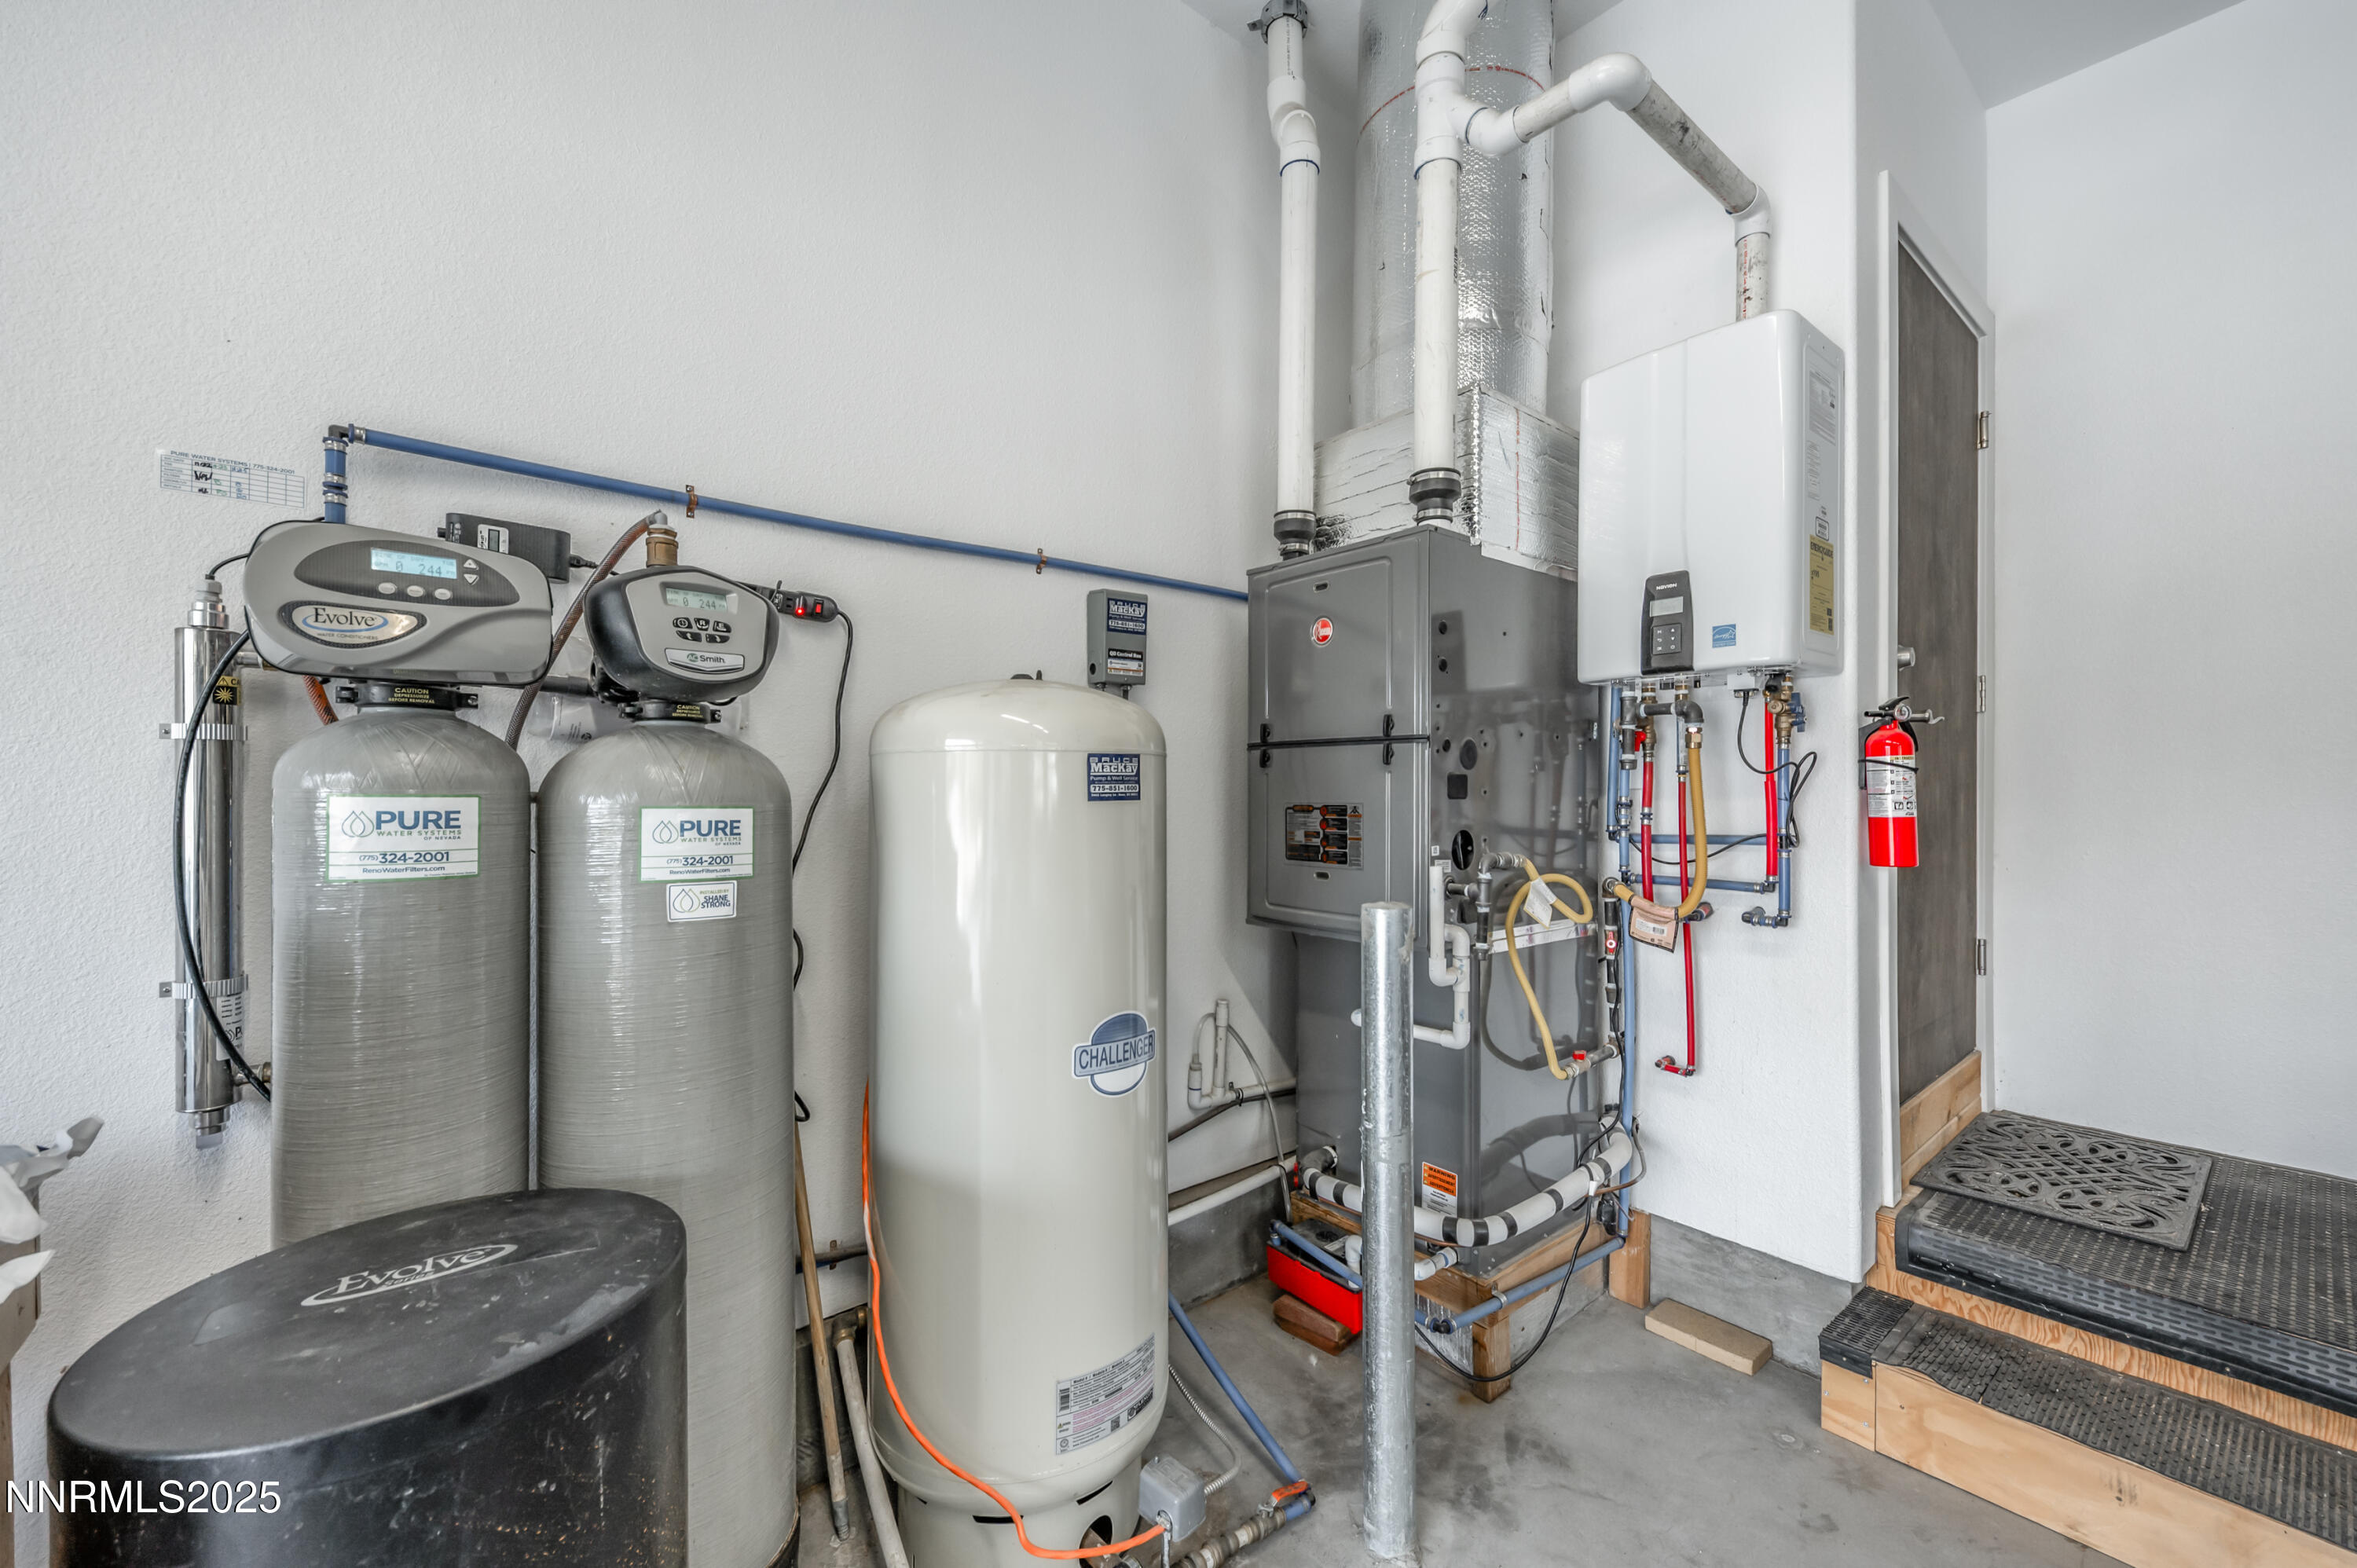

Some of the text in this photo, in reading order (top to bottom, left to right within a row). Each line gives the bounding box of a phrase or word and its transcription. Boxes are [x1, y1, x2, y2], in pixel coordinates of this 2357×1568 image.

[192, 453, 216, 462] WATER
[218, 458, 247, 467] SYSTEMS
[253, 463, 295, 474] 775-324-2001
[699, 599, 717, 610] 244
[313, 607, 376, 627] Evolve
[1109, 605, 1146, 617] MacKay
[699, 654, 724, 664] Smith
[1091, 763, 1138, 775] MacKay
[376, 810, 461, 830] PURE
[680, 819, 742, 837] PURE
[379, 851, 450, 864] 324-2001
[682, 855, 734, 866] 324-2001
[362, 866, 445, 874] RenoWaterFilters.com
[701, 899, 731, 909] STRONG
[1079, 1034, 1153, 1069] CHALLENGER
[330, 1250, 486, 1295] Evolve
